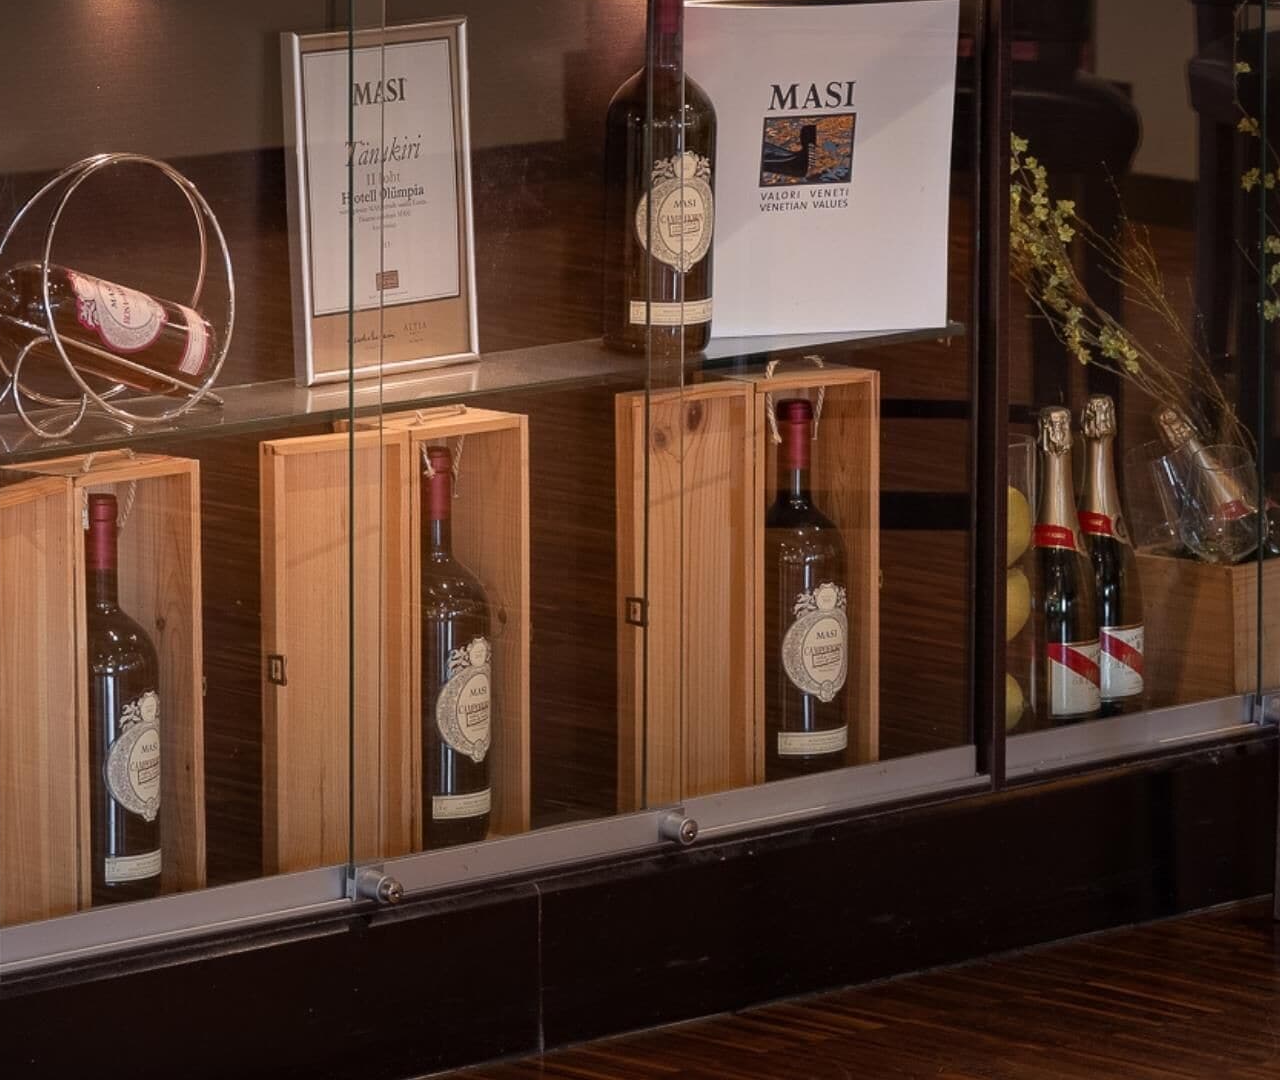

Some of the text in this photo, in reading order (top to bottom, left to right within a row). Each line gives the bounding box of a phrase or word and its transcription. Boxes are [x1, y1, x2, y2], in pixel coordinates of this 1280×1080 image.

[352, 77, 407, 106] MASI
[768, 81, 856, 111] MASI
[342, 185, 424, 205] Hotell Olümpia
[761, 188, 849, 201] VALORI VENETI
[673, 199, 697, 209] MASI
[760, 199, 848, 212] VENETIAN VALUES
[815, 629, 838, 640] MASI
